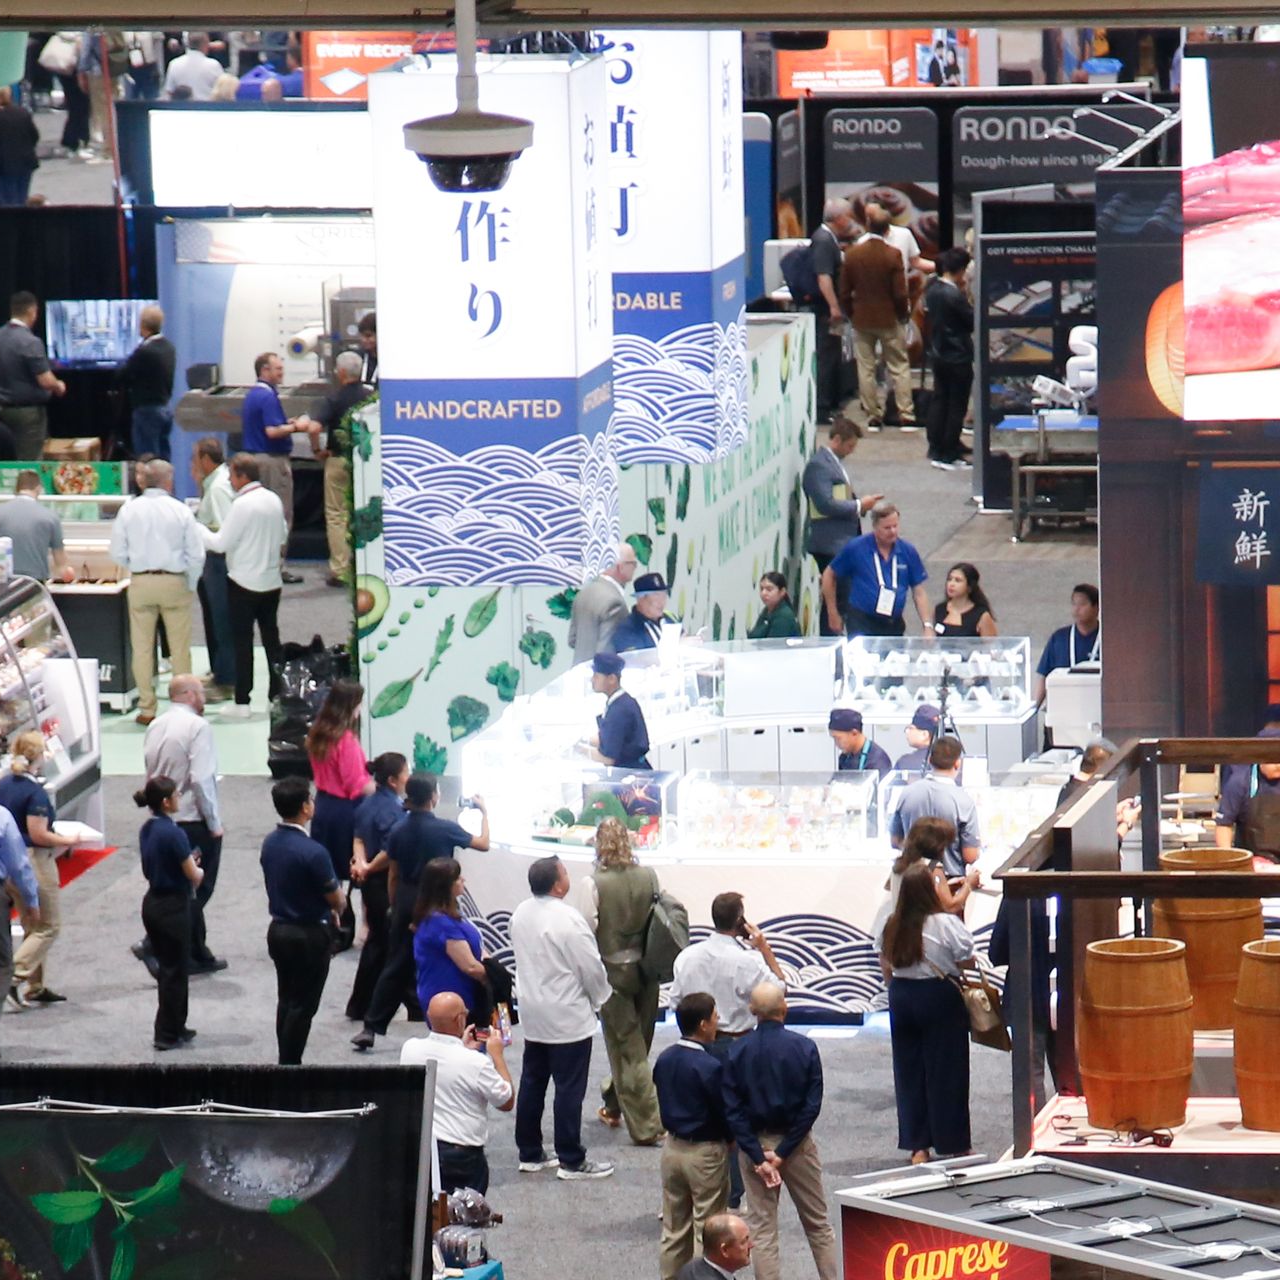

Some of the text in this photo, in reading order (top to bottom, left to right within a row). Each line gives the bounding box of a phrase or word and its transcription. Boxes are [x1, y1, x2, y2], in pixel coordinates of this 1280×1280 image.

[832, 118, 901, 134] RONDO
[960, 117, 1076, 141] RONDO
[961, 155, 1039, 169] Dough-how
[1043, 154, 1078, 166] since
[455, 200, 511, 338] 作り
[395, 400, 561, 421] HANDCRAFTED
[1232, 488, 1271, 569] 新鮮
